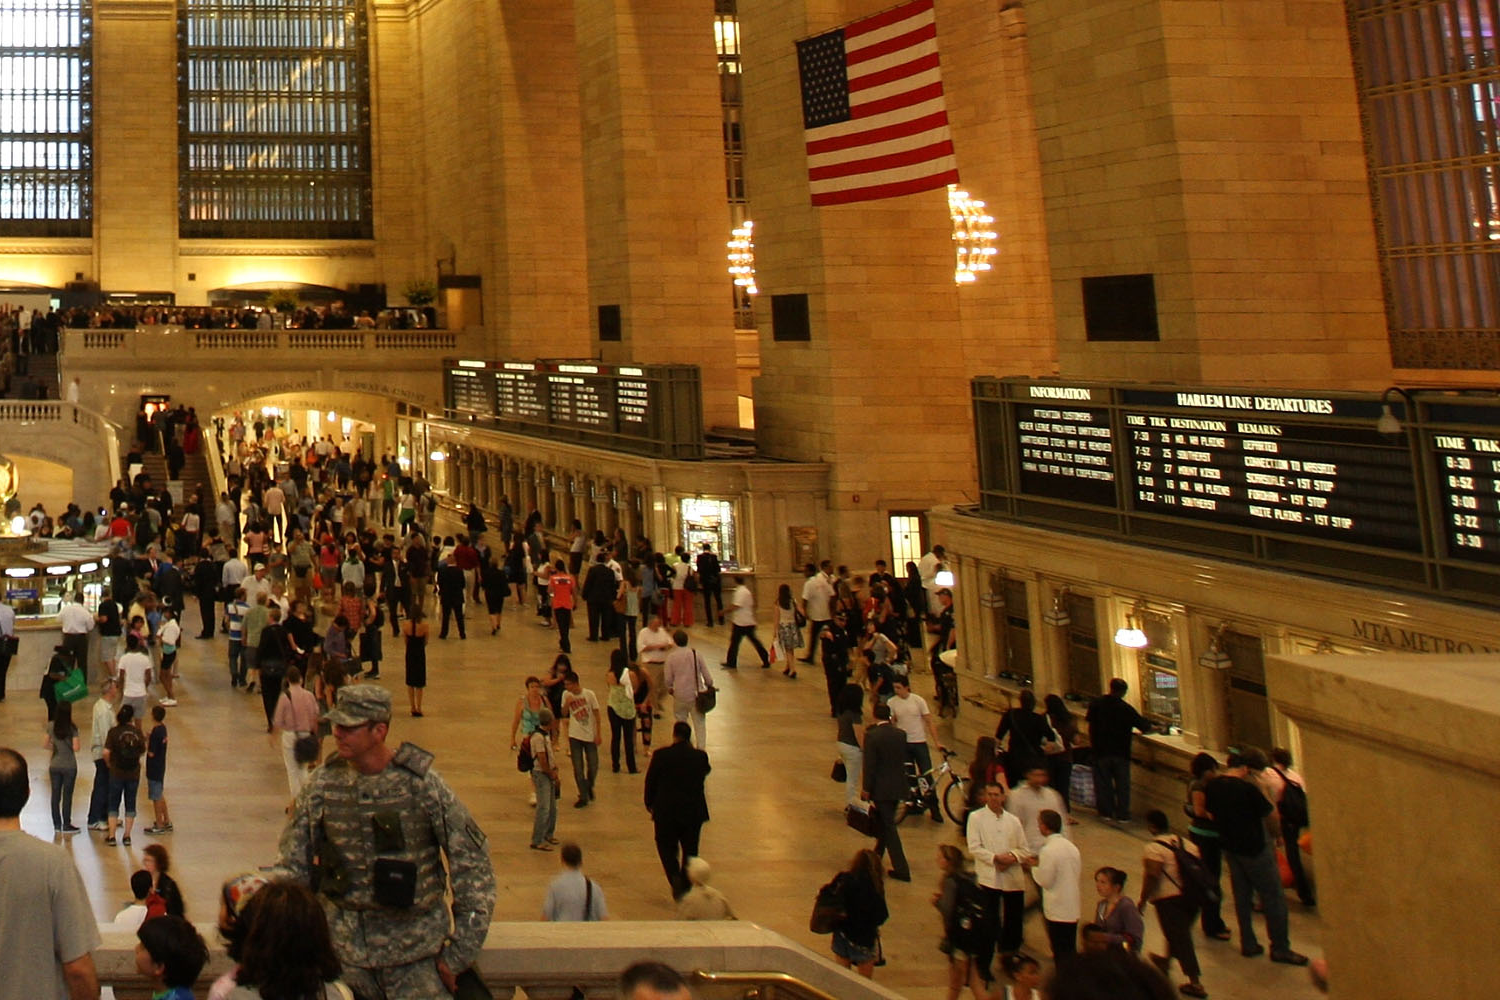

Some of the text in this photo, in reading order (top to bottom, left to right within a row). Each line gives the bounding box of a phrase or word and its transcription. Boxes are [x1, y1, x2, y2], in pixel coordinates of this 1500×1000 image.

[1030, 386, 1090, 400] INFORMATION
[1177, 393, 1333, 414] HARLEM LINE DEPARTURES
[1126, 415, 1282, 436] TIME TRK DESTINATION REMARKS
[1435, 436, 1466, 450] TIME
[1297, 478, 1311, 490] 1ST
[1313, 480, 1334, 492] STOP
[1290, 494, 1304, 506] 1ST
[1307, 496, 1328, 509] STOP
[1314, 514, 1328, 526] 1ST
[1331, 516, 1353, 530] STOP
[1454, 513, 1479, 529] 9:22
[1351, 618, 1475, 654] MTA METRO
